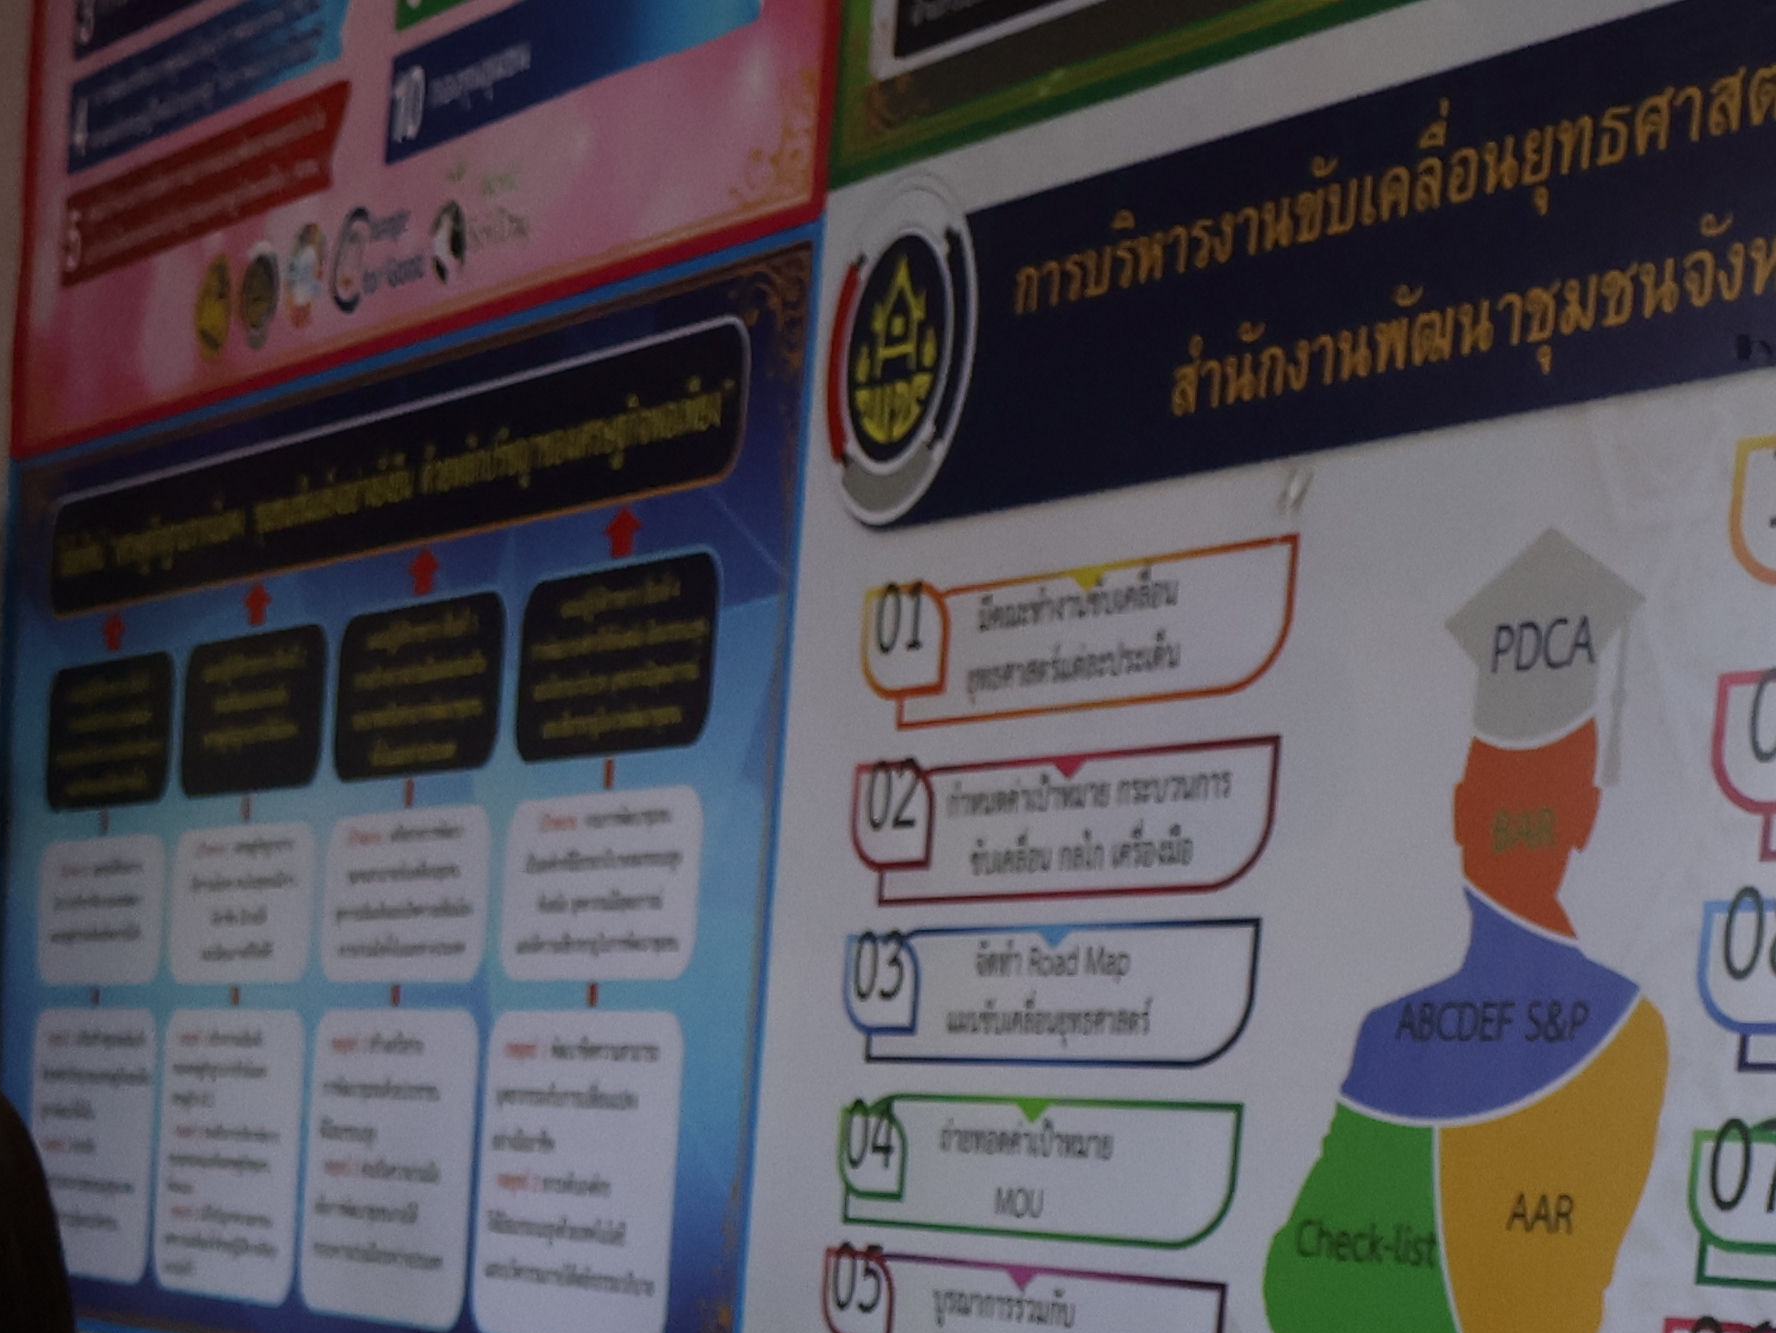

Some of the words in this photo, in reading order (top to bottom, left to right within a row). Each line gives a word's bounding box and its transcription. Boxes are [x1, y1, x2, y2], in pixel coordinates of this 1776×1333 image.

[874, 580, 926, 654] 01
[1489, 615, 1596, 673] PDCA
[865, 756, 918, 832] 02
[852, 927, 905, 1001] 03
[1028, 945, 1079, 977] Road
[1083, 948, 1132, 983] Map
[1395, 999, 1515, 1043] ABCDEF
[1523, 1001, 1591, 1042] S&P
[846, 1097, 895, 1170] 04
[993, 1186, 1045, 1219] MOU
[1505, 1193, 1575, 1235] AAR
[1295, 1219, 1438, 1269] Check-list
[831, 1241, 885, 1314] 05
